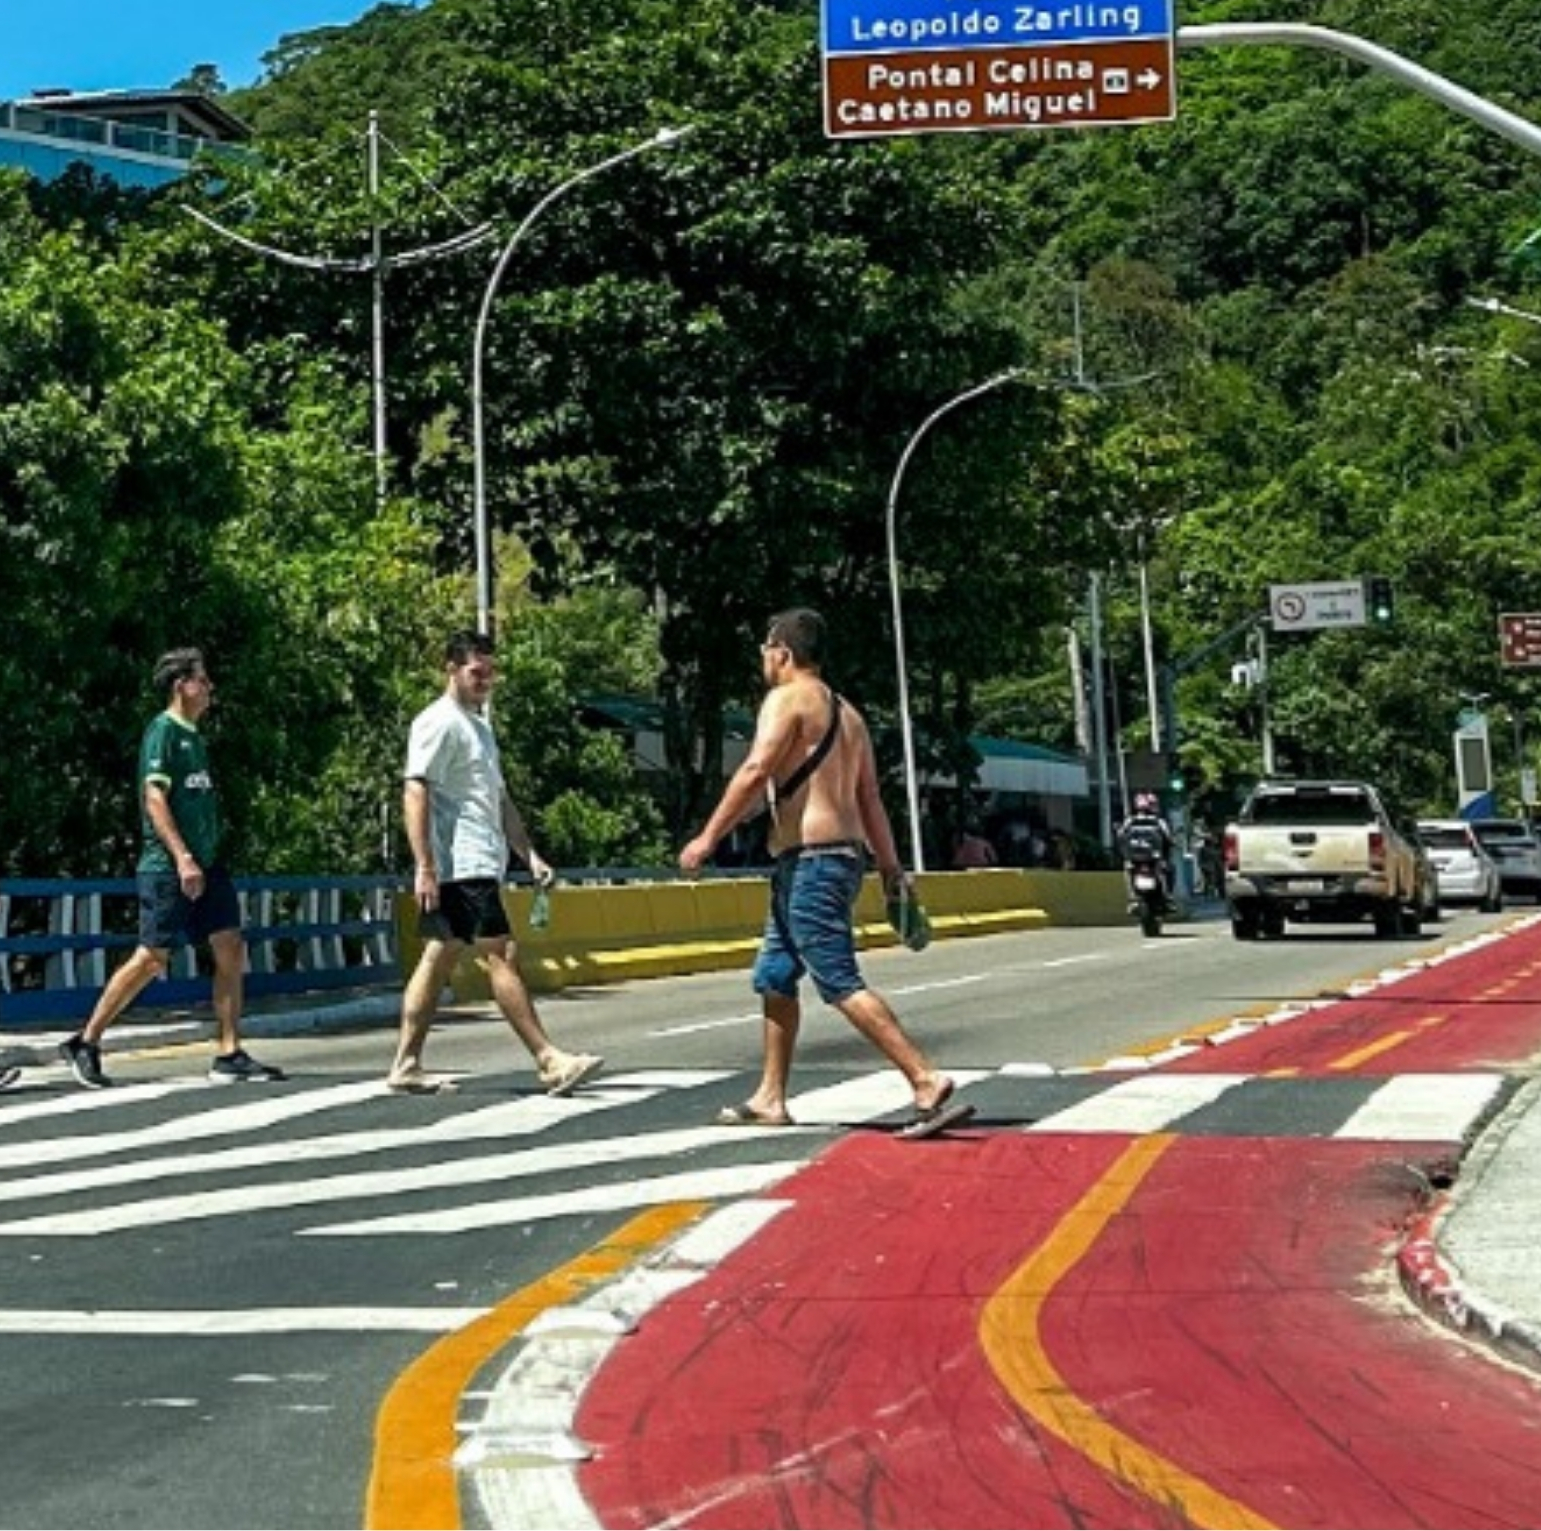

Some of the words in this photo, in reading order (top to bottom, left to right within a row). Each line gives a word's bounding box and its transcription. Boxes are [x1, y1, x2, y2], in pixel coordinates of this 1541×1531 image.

[852, 8, 1001, 41] Leopoldo
[1014, 3, 1141, 31] Zarling
[868, 61, 975, 90] Pontal
[988, 56, 1094, 84] Celina
[837, 95, 971, 124] Caetano
[984, 89, 1096, 120] Miguel
